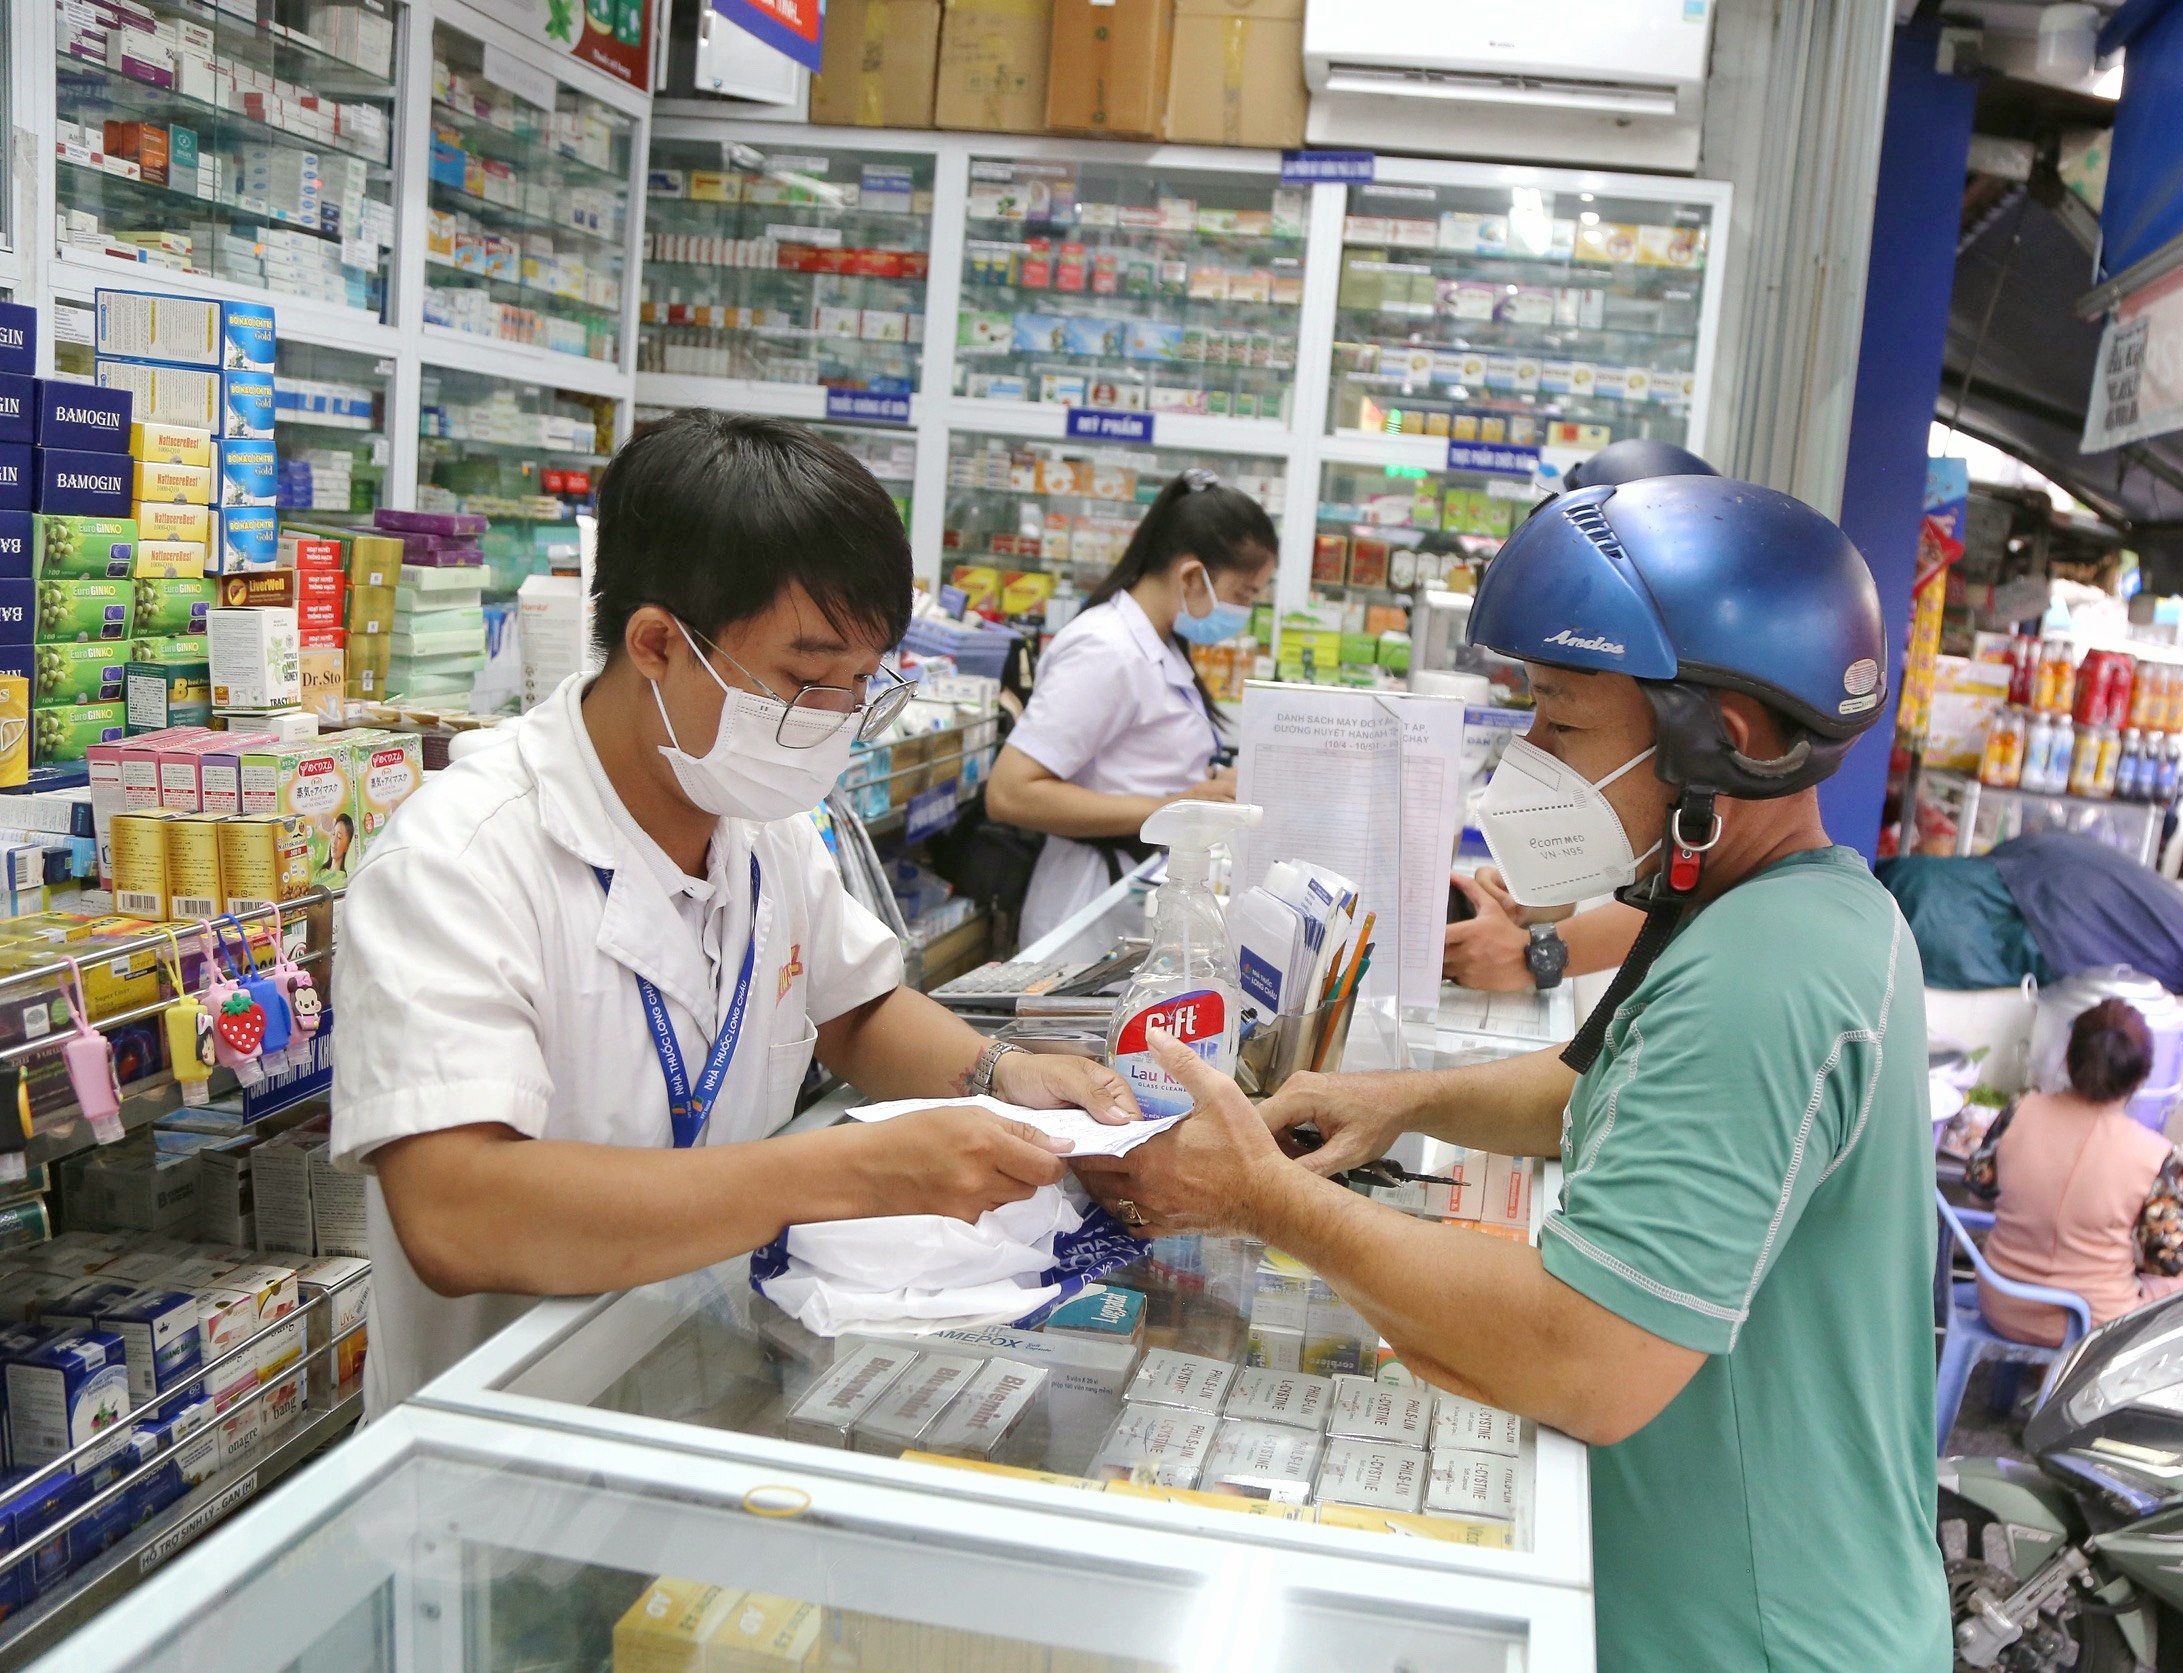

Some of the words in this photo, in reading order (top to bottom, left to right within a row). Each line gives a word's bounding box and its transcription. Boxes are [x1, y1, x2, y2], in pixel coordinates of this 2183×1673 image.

[56, 406, 120, 428] BAMOGIN
[0, 466, 18, 481] IN
[57, 473, 122, 491] BAMOGIN
[302, 671, 341, 687] Dr.Sto
[1277, 713, 1305, 723] DANH
[652, 1005, 669, 1037] LONG
[703, 1069, 720, 1091] NHÀ
[712, 1033, 733, 1069] THUỐC
[728, 1007, 741, 1035] LONG
[737, 979, 748, 1007] CHÂU
[661, 1038, 682, 1073] THUỐC
[1131, 1065, 1158, 1082] Lau
[1138, 1082, 1158, 1090] GLASS
[1199, 1369, 1223, 1400] PHILS-LIN
[1272, 1380, 1294, 1411] L-CYSTINE
[1301, 1384, 1322, 1416] PHILS-LIN
[273, 1396, 297, 1420] bang
[1374, 1392, 1393, 1426] L-CYSTINE
[1403, 1399, 1420, 1431] PHILS-LIN
[1477, 1407, 1493, 1440] L-CYSTINE
[228, 1427, 258, 1454] onagre
[1150, 1419, 1177, 1454] L-CYSTINE
[1364, 1454, 1386, 1492] L-CYSTINE
[1395, 1459, 1415, 1497] PHILS-LIN
[1472, 1462, 1490, 1501] L-CYSTINE
[181, 1519, 204, 1538] SINH
[204, 1505, 215, 1525] LÝ
[221, 1491, 241, 1508] GAN
